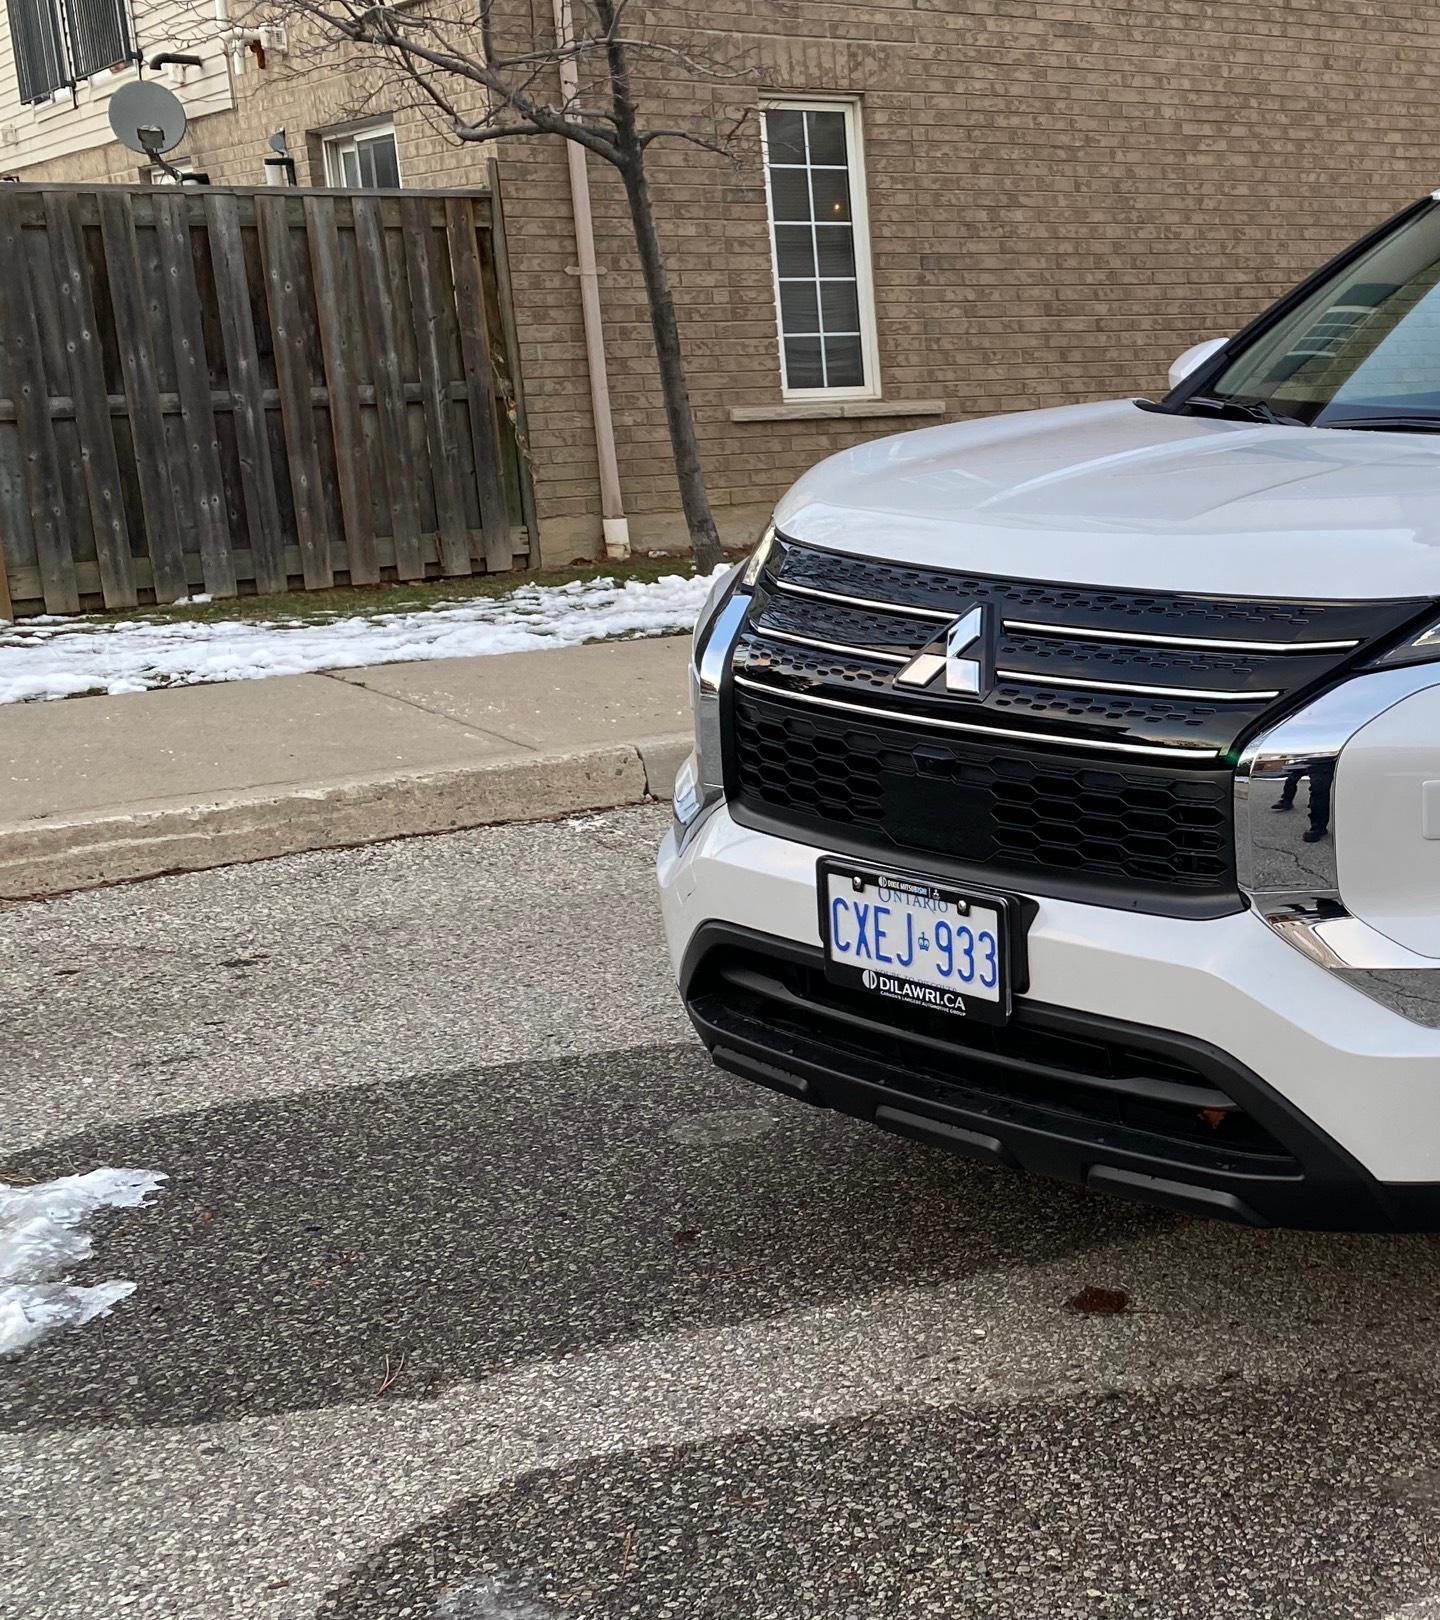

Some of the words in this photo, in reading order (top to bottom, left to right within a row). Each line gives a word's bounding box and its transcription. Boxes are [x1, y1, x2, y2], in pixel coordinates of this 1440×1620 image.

[832, 897, 914, 967] CXEJ
[934, 920, 998, 988] 933
[880, 976, 966, 1011] DILAWRI.CA
